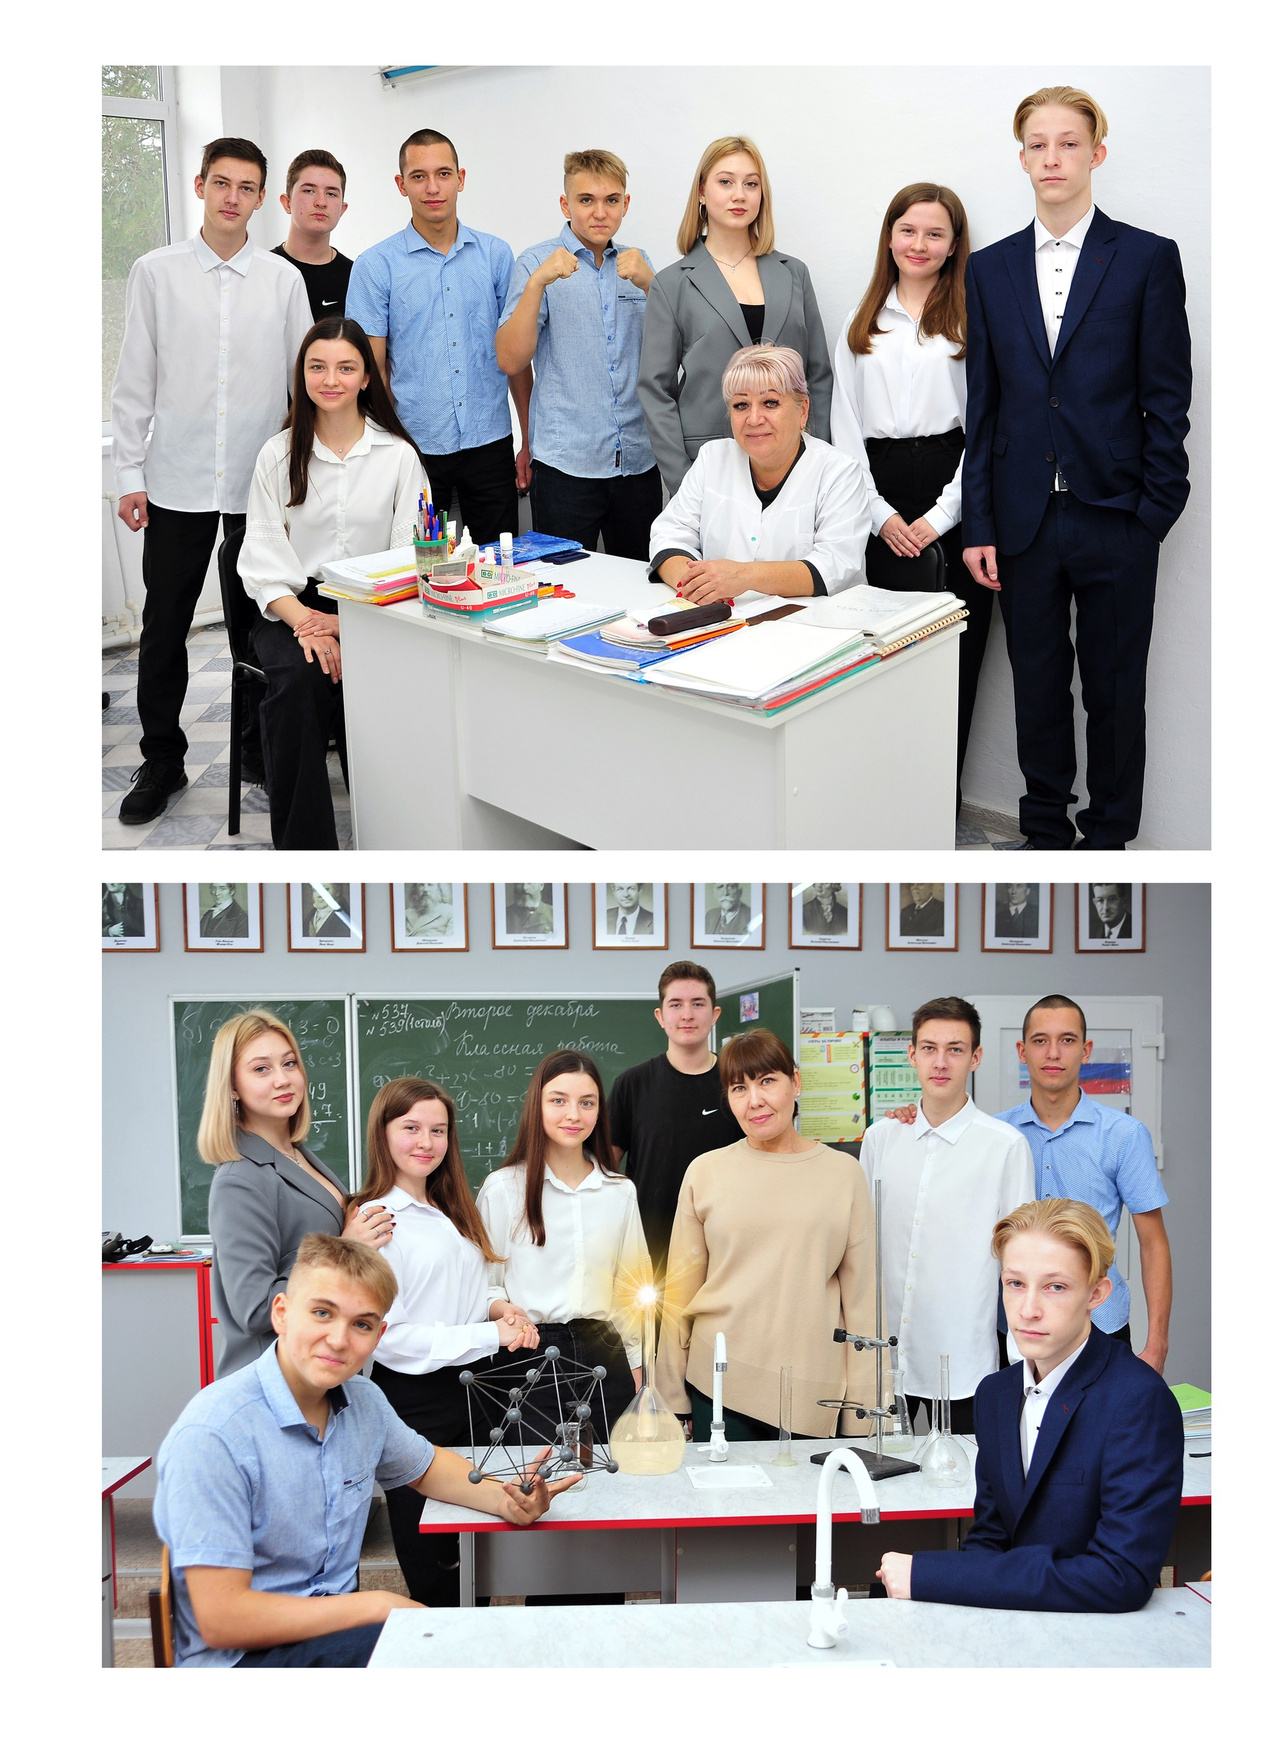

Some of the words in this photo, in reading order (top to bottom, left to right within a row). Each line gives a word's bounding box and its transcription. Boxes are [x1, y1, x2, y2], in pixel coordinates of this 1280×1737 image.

[446, 1002, 513, 1030] Второе
[526, 1001, 600, 1028] декабря
[454, 1030, 545, 1056] Классная
[557, 1036, 626, 1056] работа
